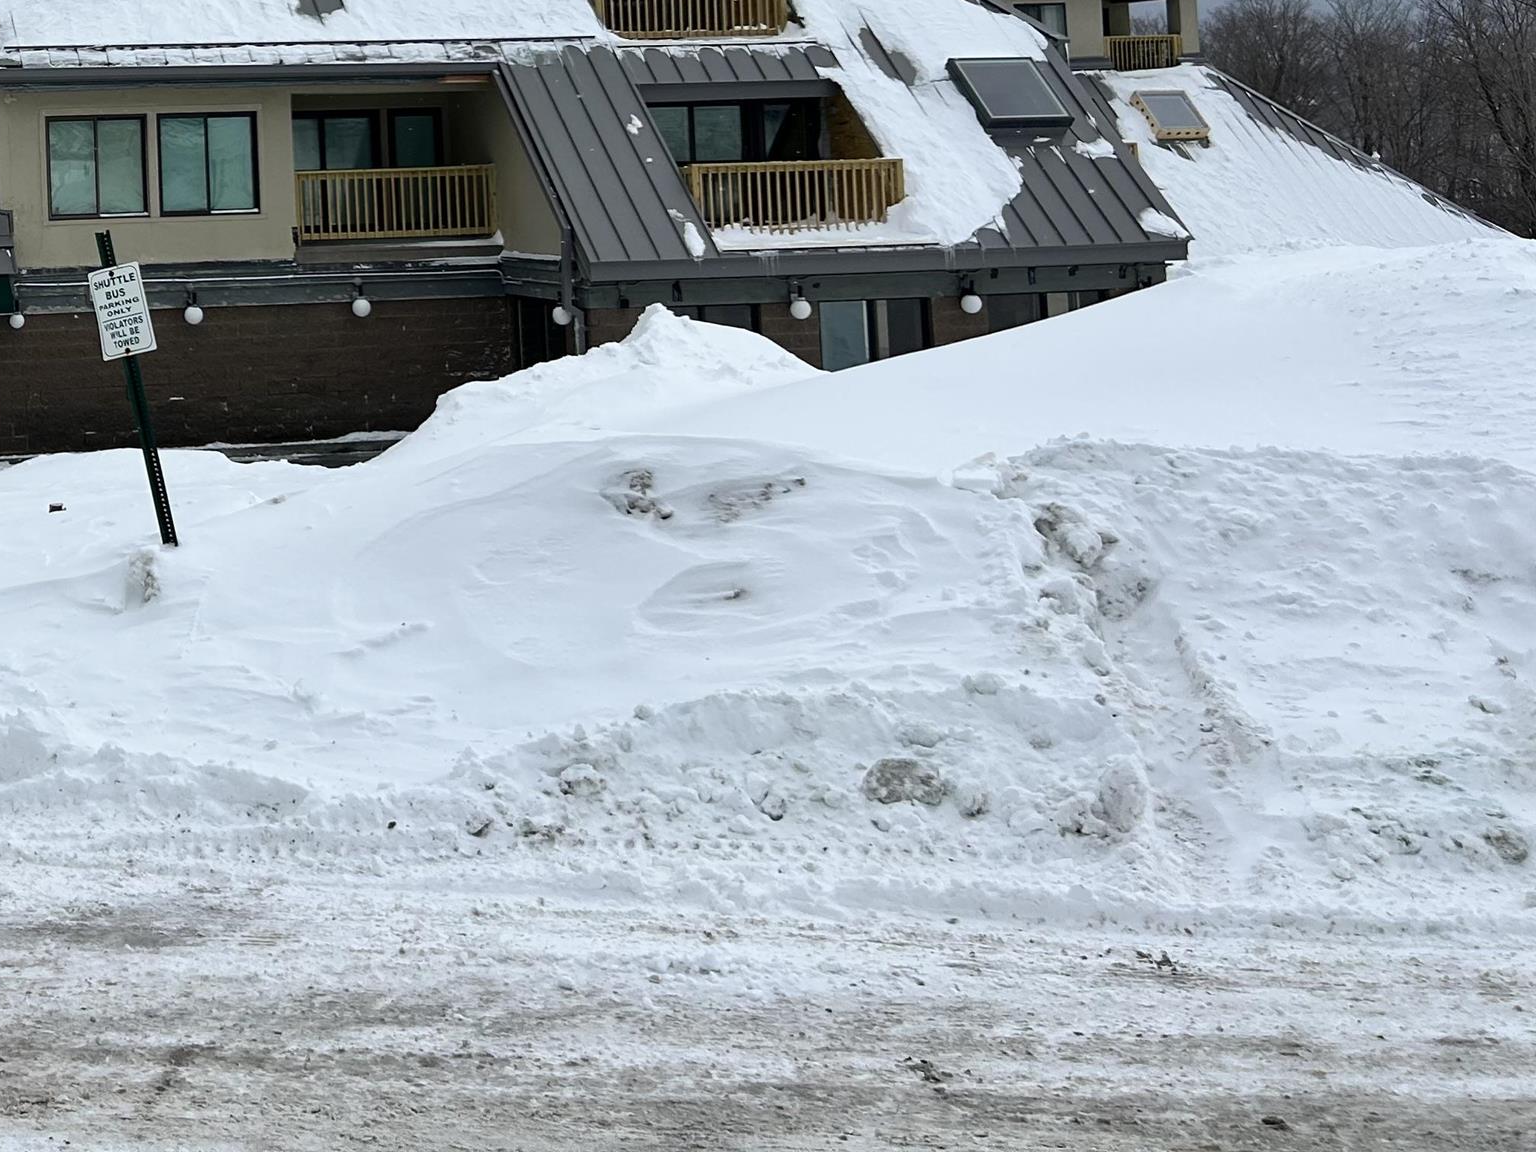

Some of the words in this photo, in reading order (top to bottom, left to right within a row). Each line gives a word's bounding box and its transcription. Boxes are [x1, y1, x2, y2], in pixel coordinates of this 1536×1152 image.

[93, 272, 136, 291] SHUTTLE
[105, 288, 126, 301] BUS
[99, 296, 140, 311] PARKING
[107, 306, 132, 317] ONLY
[104, 315, 144, 332] VIOLATORS
[110, 329, 127, 339] WILL
[129, 326, 140, 336] BE
[113, 336, 140, 349] TOWED
